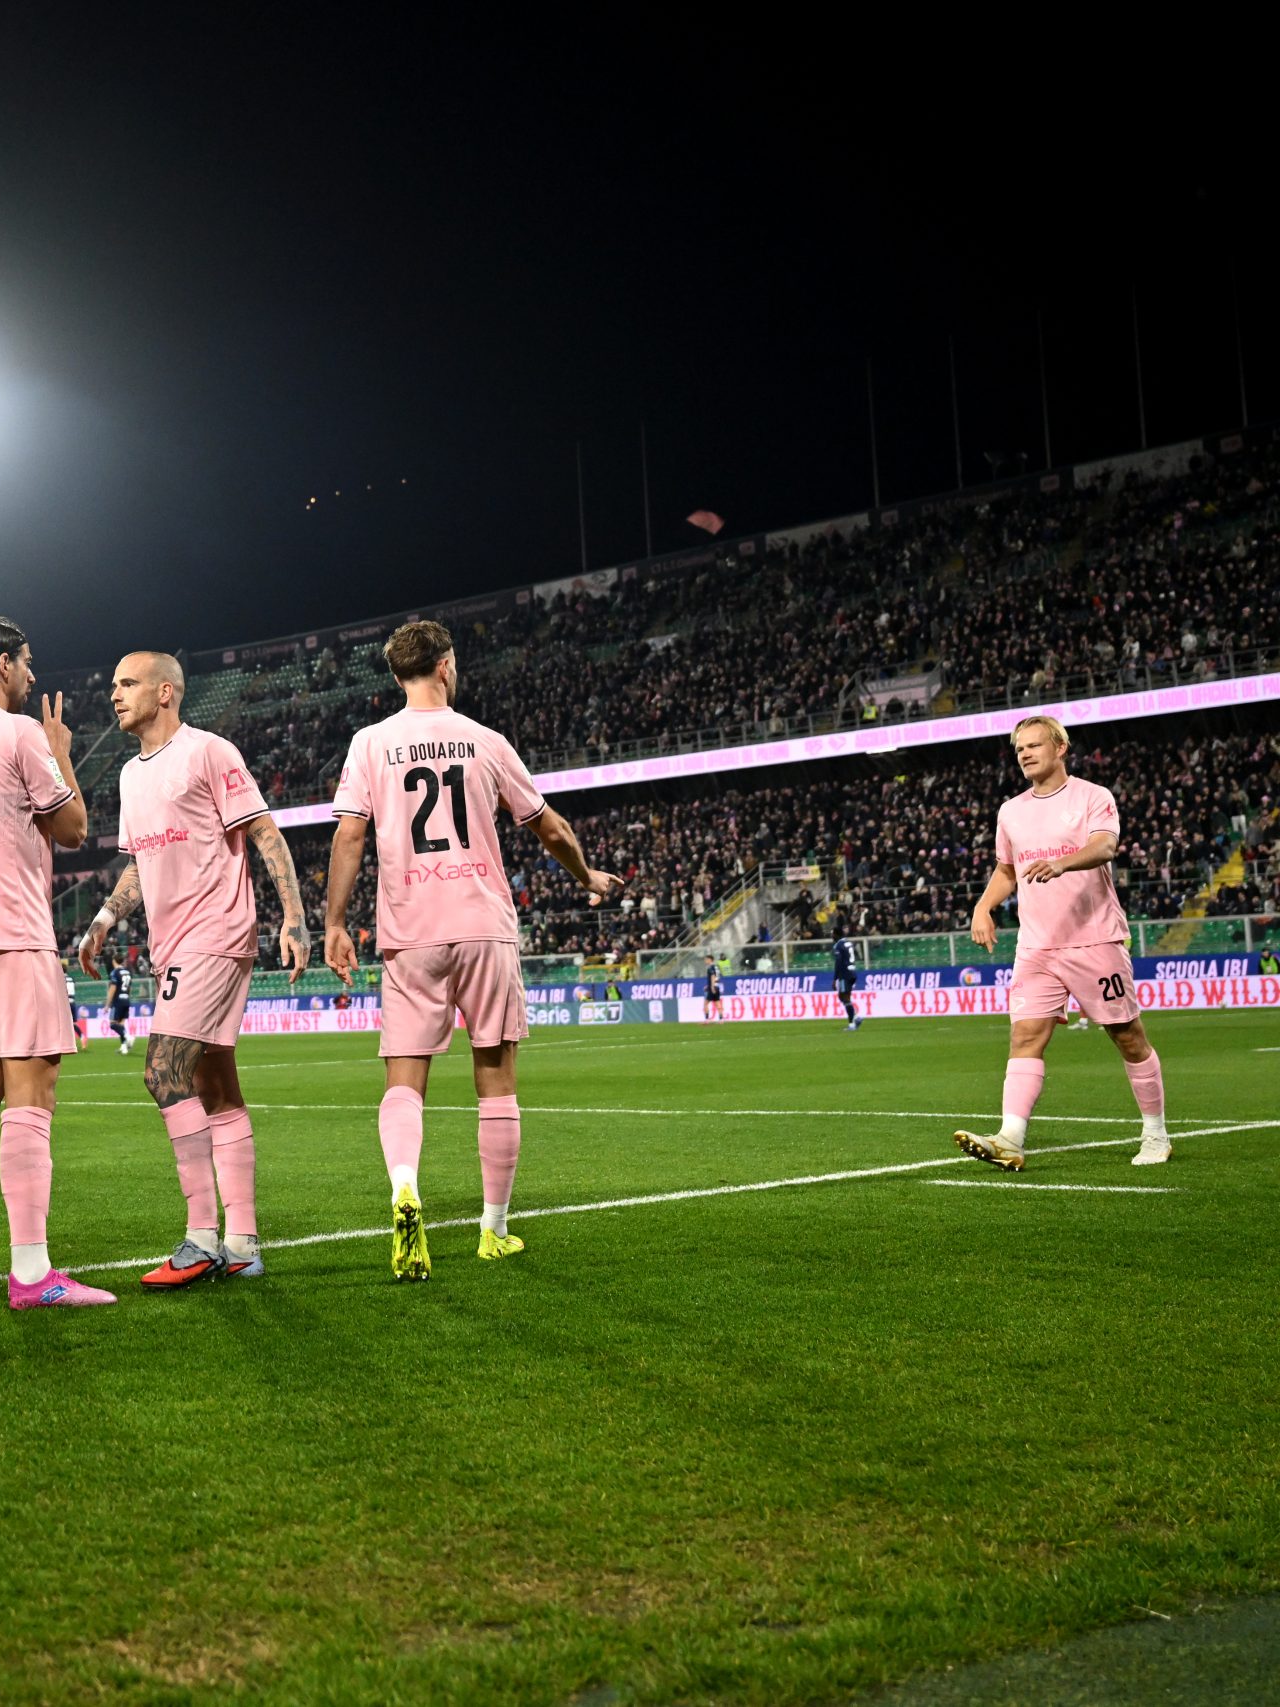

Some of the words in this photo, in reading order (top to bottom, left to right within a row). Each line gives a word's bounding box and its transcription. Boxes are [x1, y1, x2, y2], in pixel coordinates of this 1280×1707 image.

[386, 747, 405, 766] LE
[409, 741, 476, 762] DOUARON
[403, 764, 471, 855] 21
[1155, 960, 1218, 980] SCUOLA
[1223, 958, 1249, 977] IBI
[162, 966, 182, 1001] 5
[631, 983, 673, 1000] SCUOLA
[676, 982, 694, 998] IBI
[735, 976, 817, 995] SCUOLAIBI.IT
[865, 972, 917, 990] SCUOLA
[919, 971, 941, 988] IBI
[1098, 973, 1126, 1002] 20
[549, 988, 566, 1003] IBI
[900, 989, 950, 1014] OLD
[955, 987, 1011, 1013] WIL
[1136, 981, 1195, 1008] OLD
[1201, 977, 1280, 1006] WILD
[526, 1005, 571, 1025] Serie
[581, 1005, 620, 1020] BKT
[749, 993, 807, 1019] WILD
[243, 1013, 277, 1032] WILD
[280, 1012, 321, 1031] WEST
[337, 1011, 368, 1030] OLD
